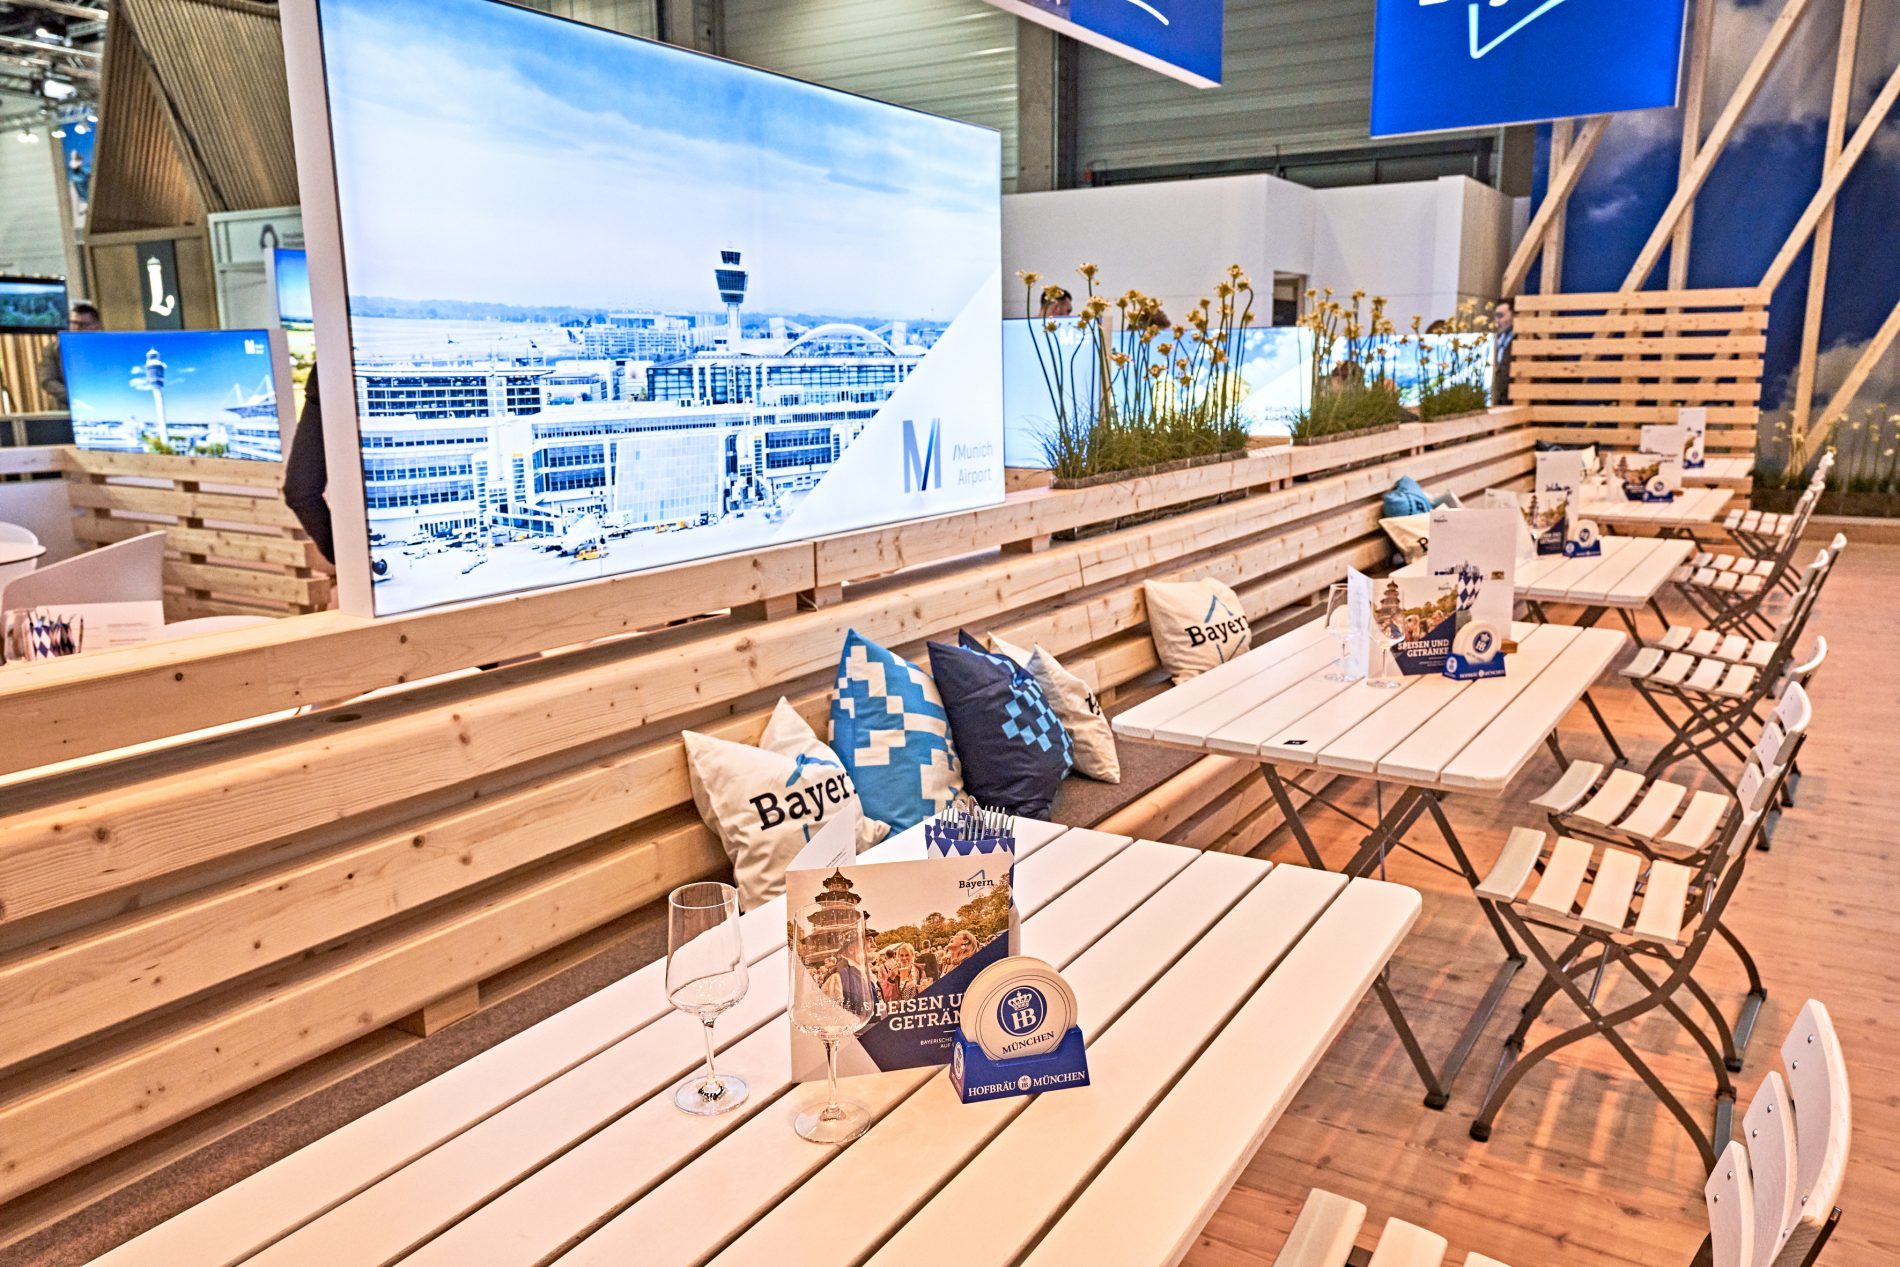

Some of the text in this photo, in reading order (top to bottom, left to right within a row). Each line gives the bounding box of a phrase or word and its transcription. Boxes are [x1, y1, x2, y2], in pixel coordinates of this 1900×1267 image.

[958, 467, 992, 488] Airport
[1431, 638, 1450, 648] UND
[748, 771, 857, 832] Bayer
[958, 879, 994, 890] Bayern
[888, 1008, 962, 1032] GETRÄN
[1011, 1007, 1038, 1031] HB
[920, 1036, 953, 1046] BAYERISCHE
[1001, 1030, 1056, 1055] MÜNCHEN
[968, 1080, 1017, 1097] HOFBRÄU
[1033, 1070, 1086, 1088] MÜNCHEN
